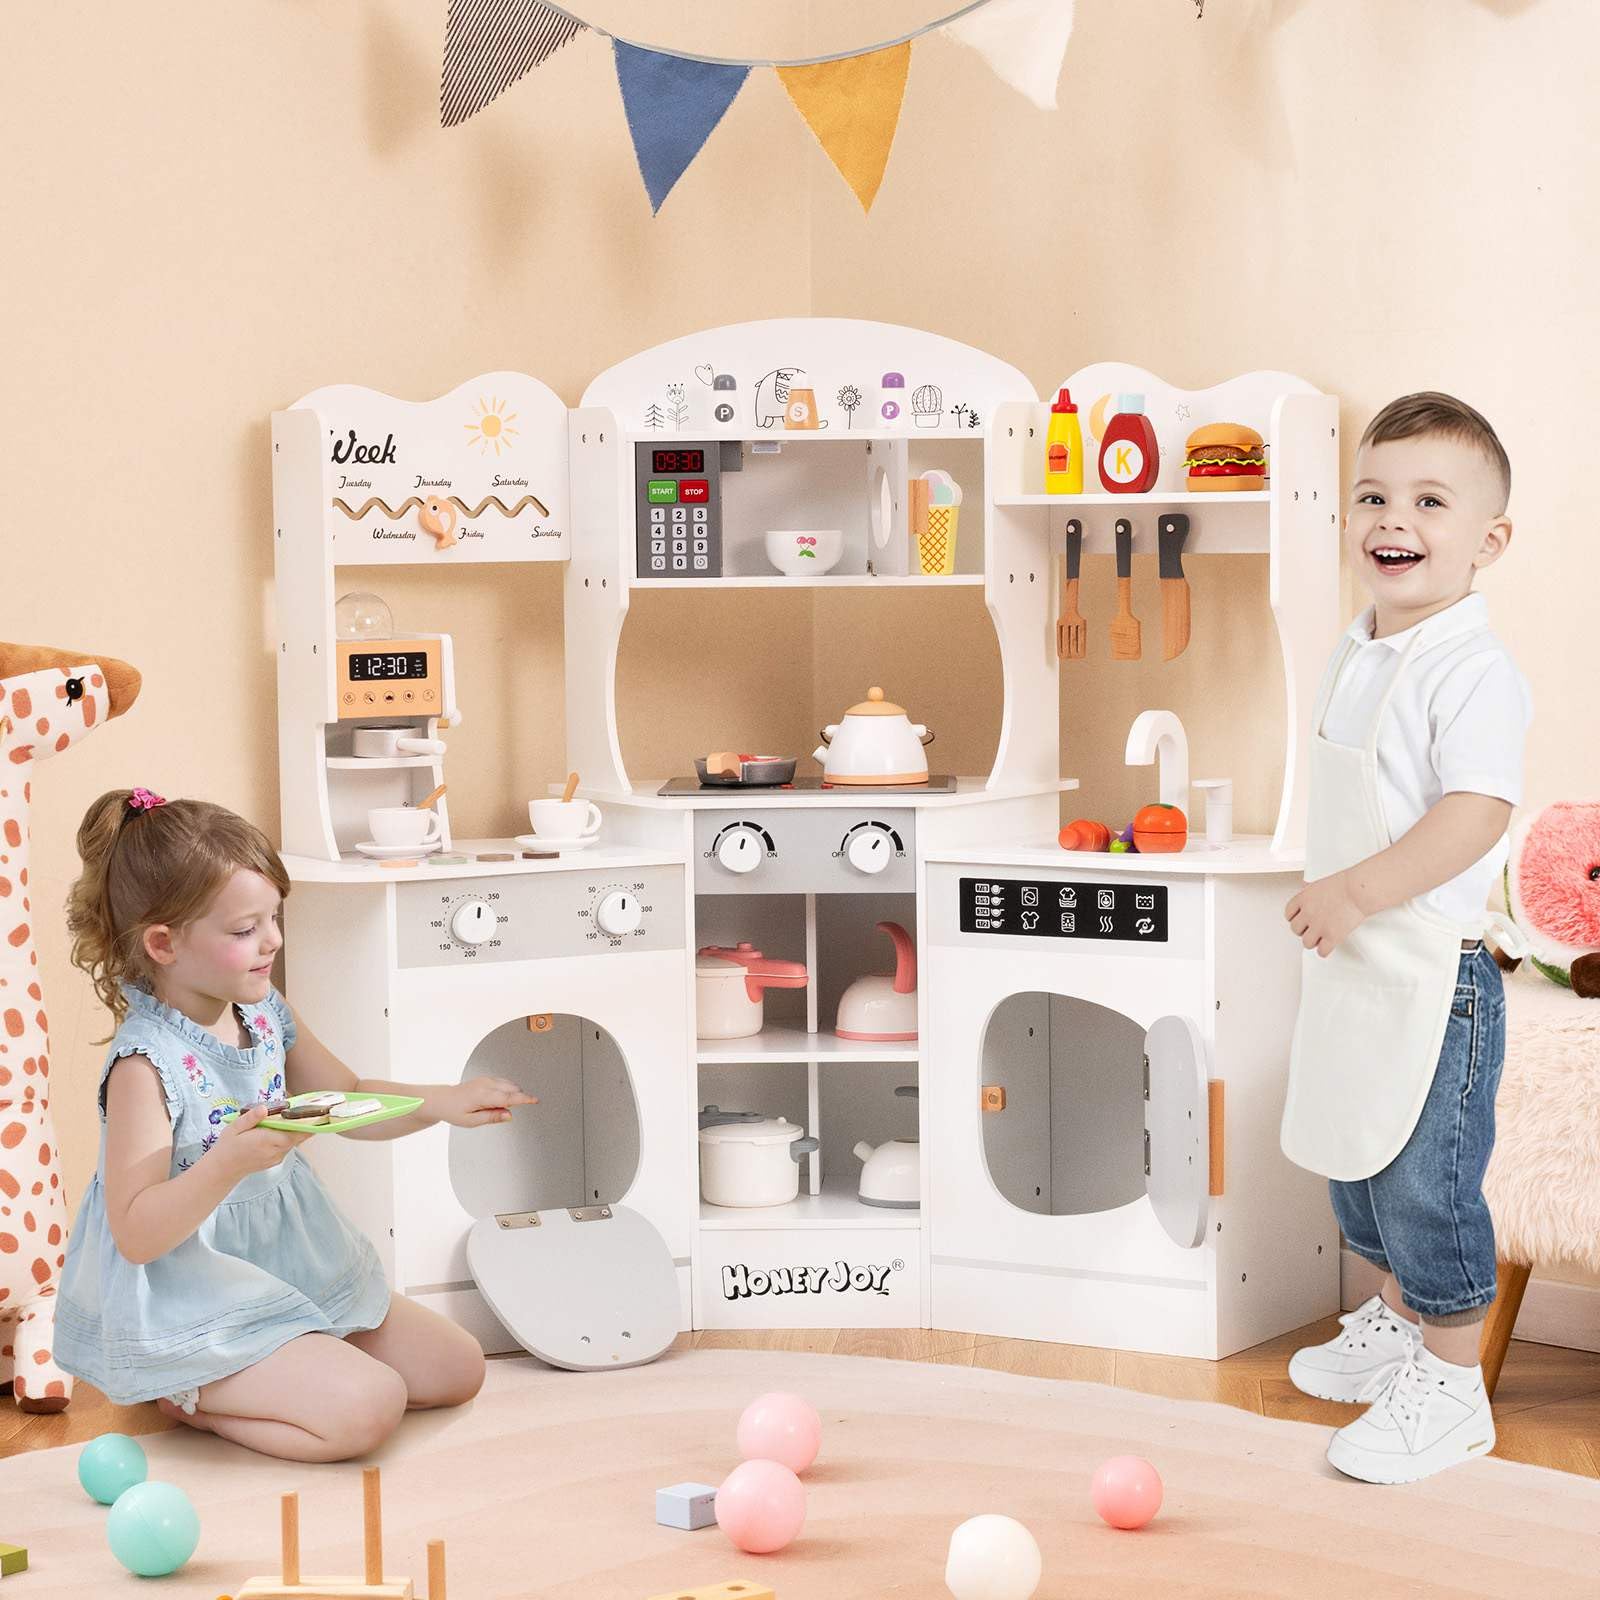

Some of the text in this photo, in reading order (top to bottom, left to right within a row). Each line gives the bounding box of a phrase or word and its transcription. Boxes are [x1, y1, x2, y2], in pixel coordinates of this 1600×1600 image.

[717, 406, 729, 420] P
[793, 405, 805, 418] S
[885, 404, 895, 417] P
[655, 453, 700, 471] 09:30
[1116, 447, 1132, 475] K
[338, 475, 372, 489] Tuesday
[413, 474, 452, 489] Thursday
[491, 474, 529, 488] Saturday
[651, 487, 674, 496] START
[684, 488, 704, 496] STOP
[654, 510, 704, 520] 1 2 3
[372, 527, 417, 540] Wednesday
[458, 527, 485, 541] Friday
[531, 525, 562, 539] Sunday
[654, 525, 704, 536] 4 5 6
[654, 541, 704, 552] 7 8 9
[675, 558, 683, 568] 0
[367, 656, 407, 676] 12:30
[588, 885, 597, 894] 50
[632, 882, 645, 891] 350
[441, 895, 450, 904] 50
[487, 893, 500, 901] 350
[577, 909, 589, 917] 100
[641, 905, 653, 913] 300
[430, 919, 443, 928] 100
[496, 915, 509, 923] 300
[585, 931, 598, 940] 150
[633, 929, 646, 937] 250
[439, 942, 451, 951] 150
[489, 939, 501, 948] 250
[609, 938, 622, 947] 200
[463, 949, 477, 958] 200
[721, 1263, 829, 1301] HONEY
